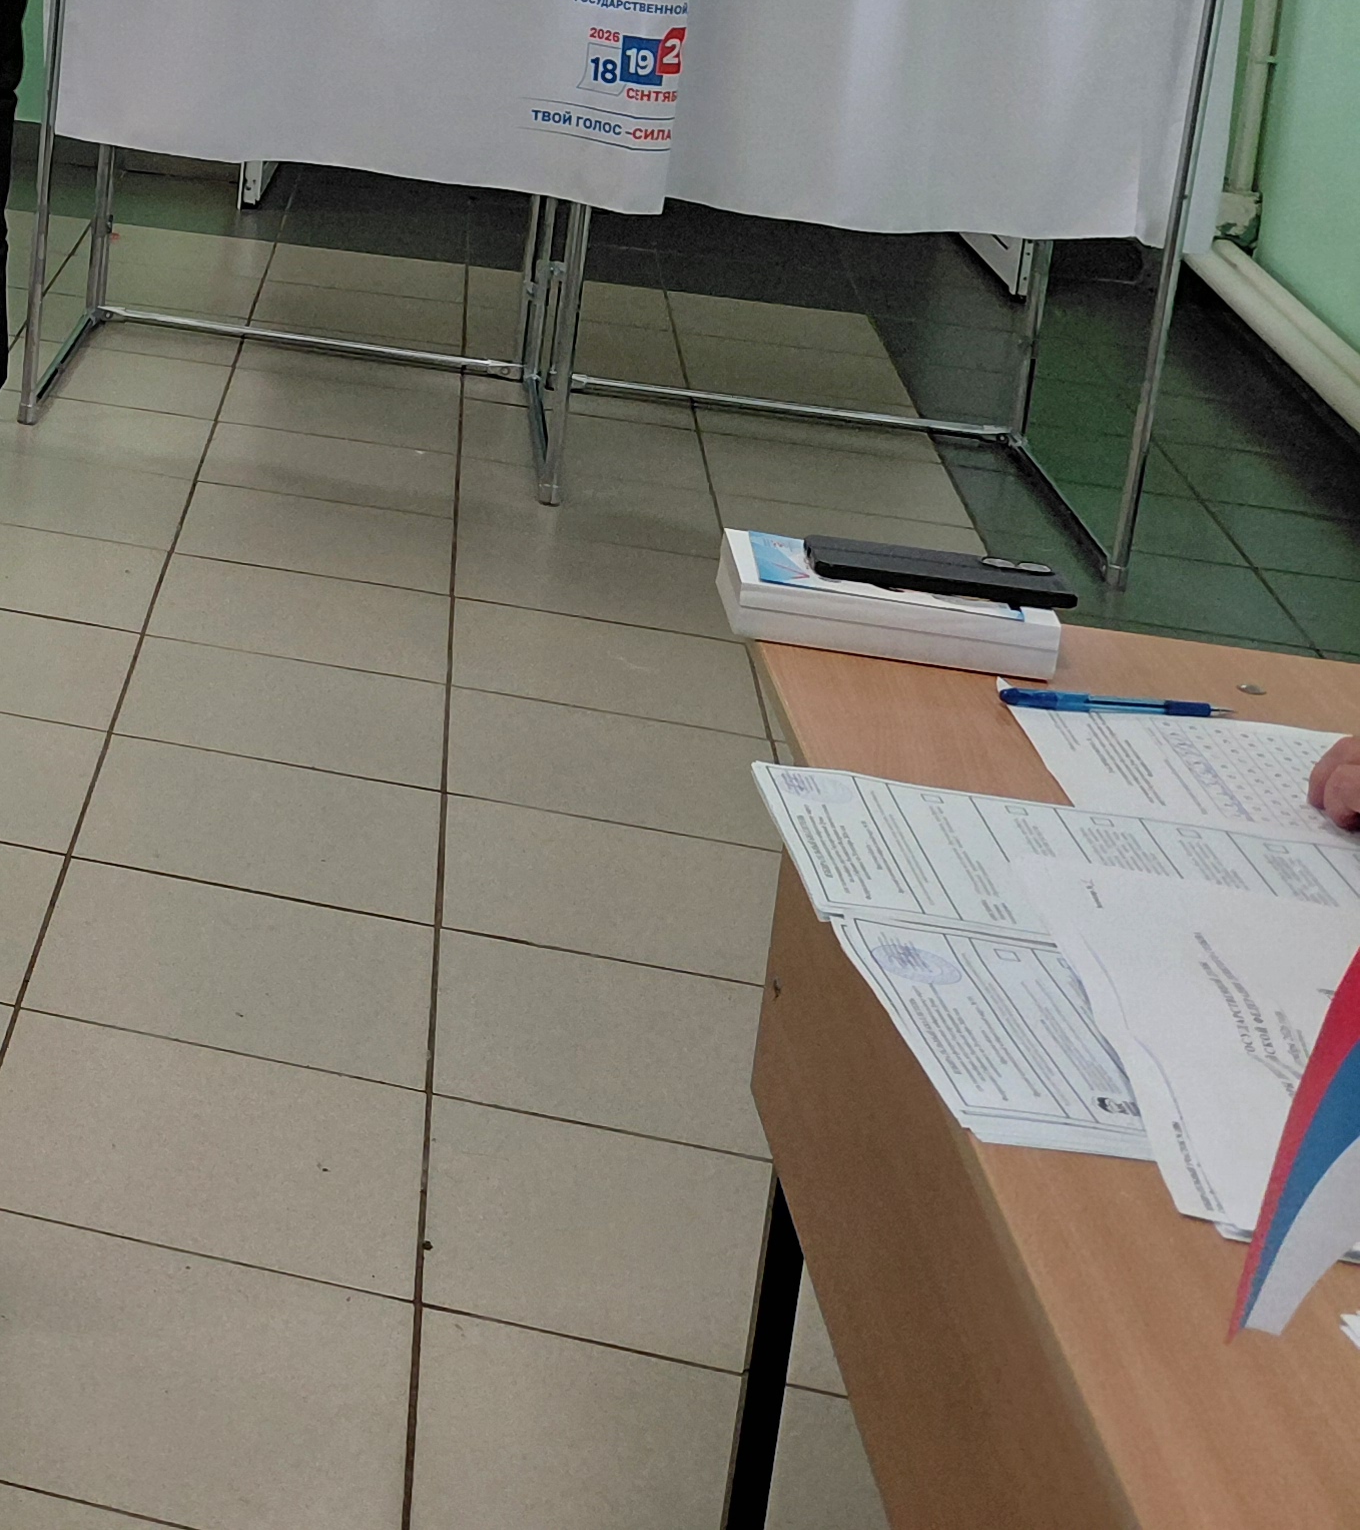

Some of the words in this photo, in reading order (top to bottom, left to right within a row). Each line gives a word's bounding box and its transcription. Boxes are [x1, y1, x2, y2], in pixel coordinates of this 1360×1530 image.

[589, 27, 621, 43] 2026
[590, 56, 618, 84] 18
[625, 47, 655, 76] 19
[531, 109, 573, 126] ТВОЙ
[576, 116, 623, 136] ГОЛОС
